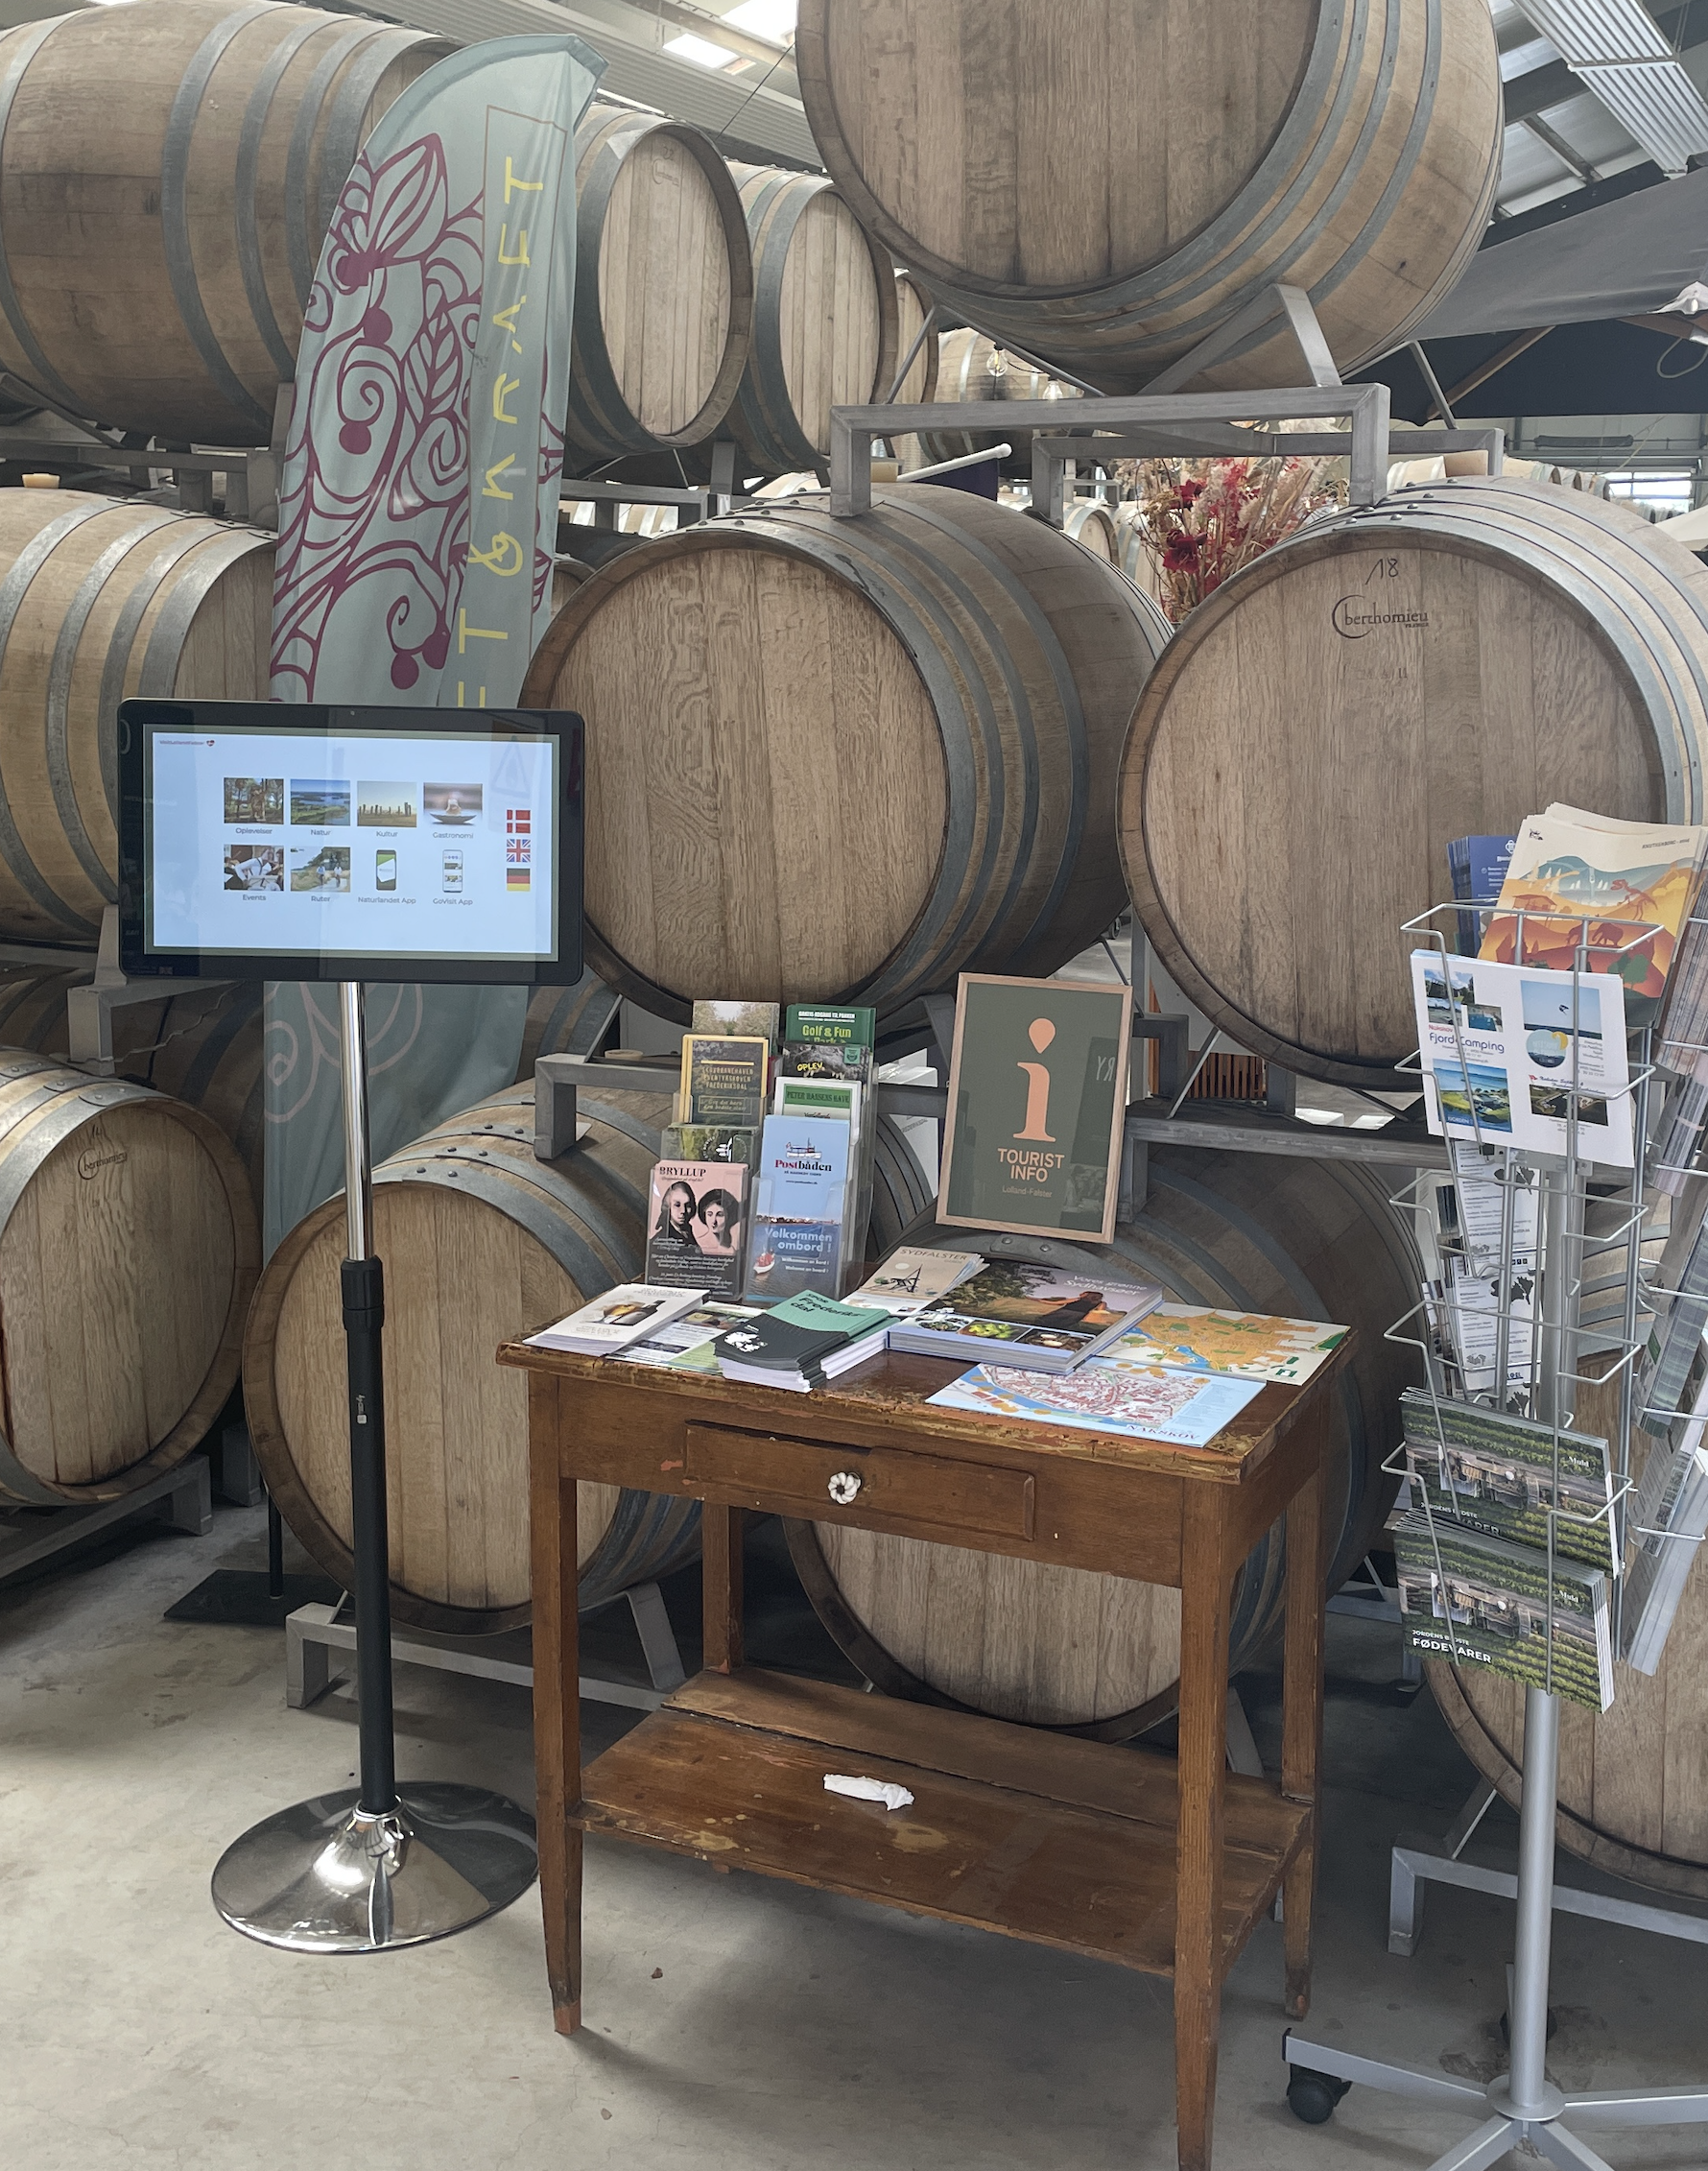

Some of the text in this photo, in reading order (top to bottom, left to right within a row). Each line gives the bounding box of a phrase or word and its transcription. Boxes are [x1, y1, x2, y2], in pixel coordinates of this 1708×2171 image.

[1364, 558, 1399, 585] 18
[802, 1024, 852, 1038] Golf & Fun
[1429, 1032, 1455, 1044] Fjord
[1455, 1036, 1505, 1054] Camping
[774, 1159, 832, 1172] Postbåden
[997, 1148, 1065, 1169] TOURIST
[659, 1166, 706, 1177] BRYLLUP
[1010, 1164, 1049, 1182] INFO
[765, 1227, 832, 1242] Velkommen
[777, 1240, 823, 1252] ombord
[900, 1249, 968, 1260] SYDFALSTER
[1074, 1276, 1103, 1284] Vores
[1125, 1424, 1200, 1440] NAKSKOV
[1568, 1456, 1589, 1467] Muld
[1559, 1589, 1579, 1604] Muld
